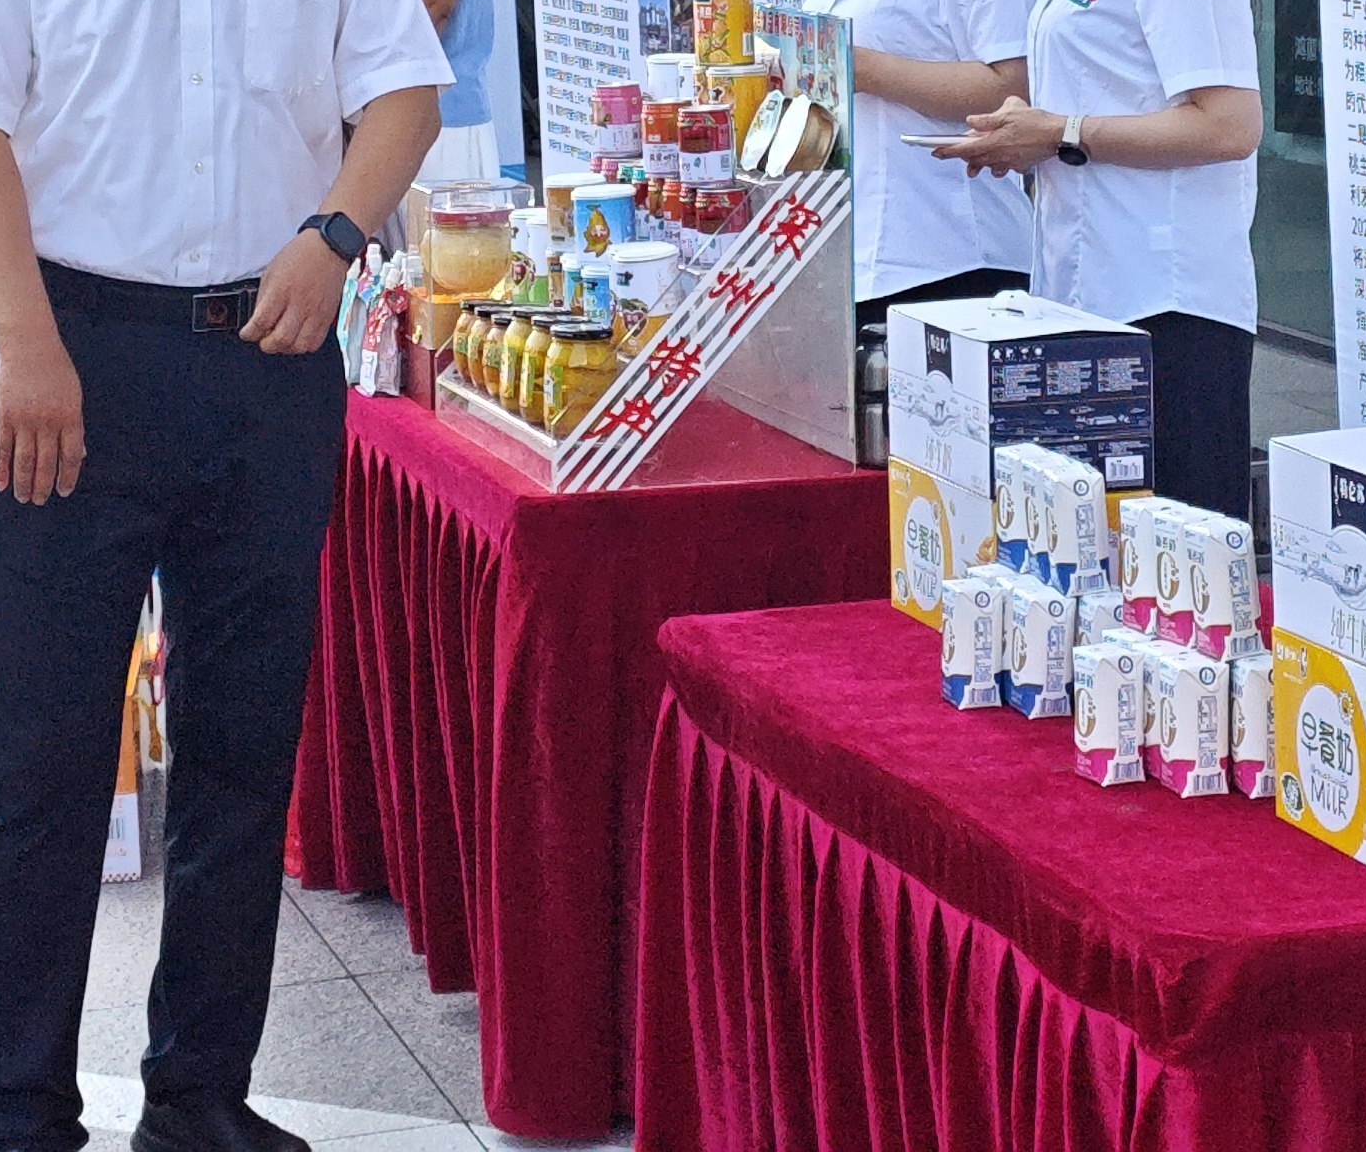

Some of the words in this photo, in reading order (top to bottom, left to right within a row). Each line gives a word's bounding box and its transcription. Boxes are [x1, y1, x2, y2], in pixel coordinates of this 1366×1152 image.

[584, 193, 823, 440] 深州特产
[1301, 711, 1355, 776] 早餐奶
